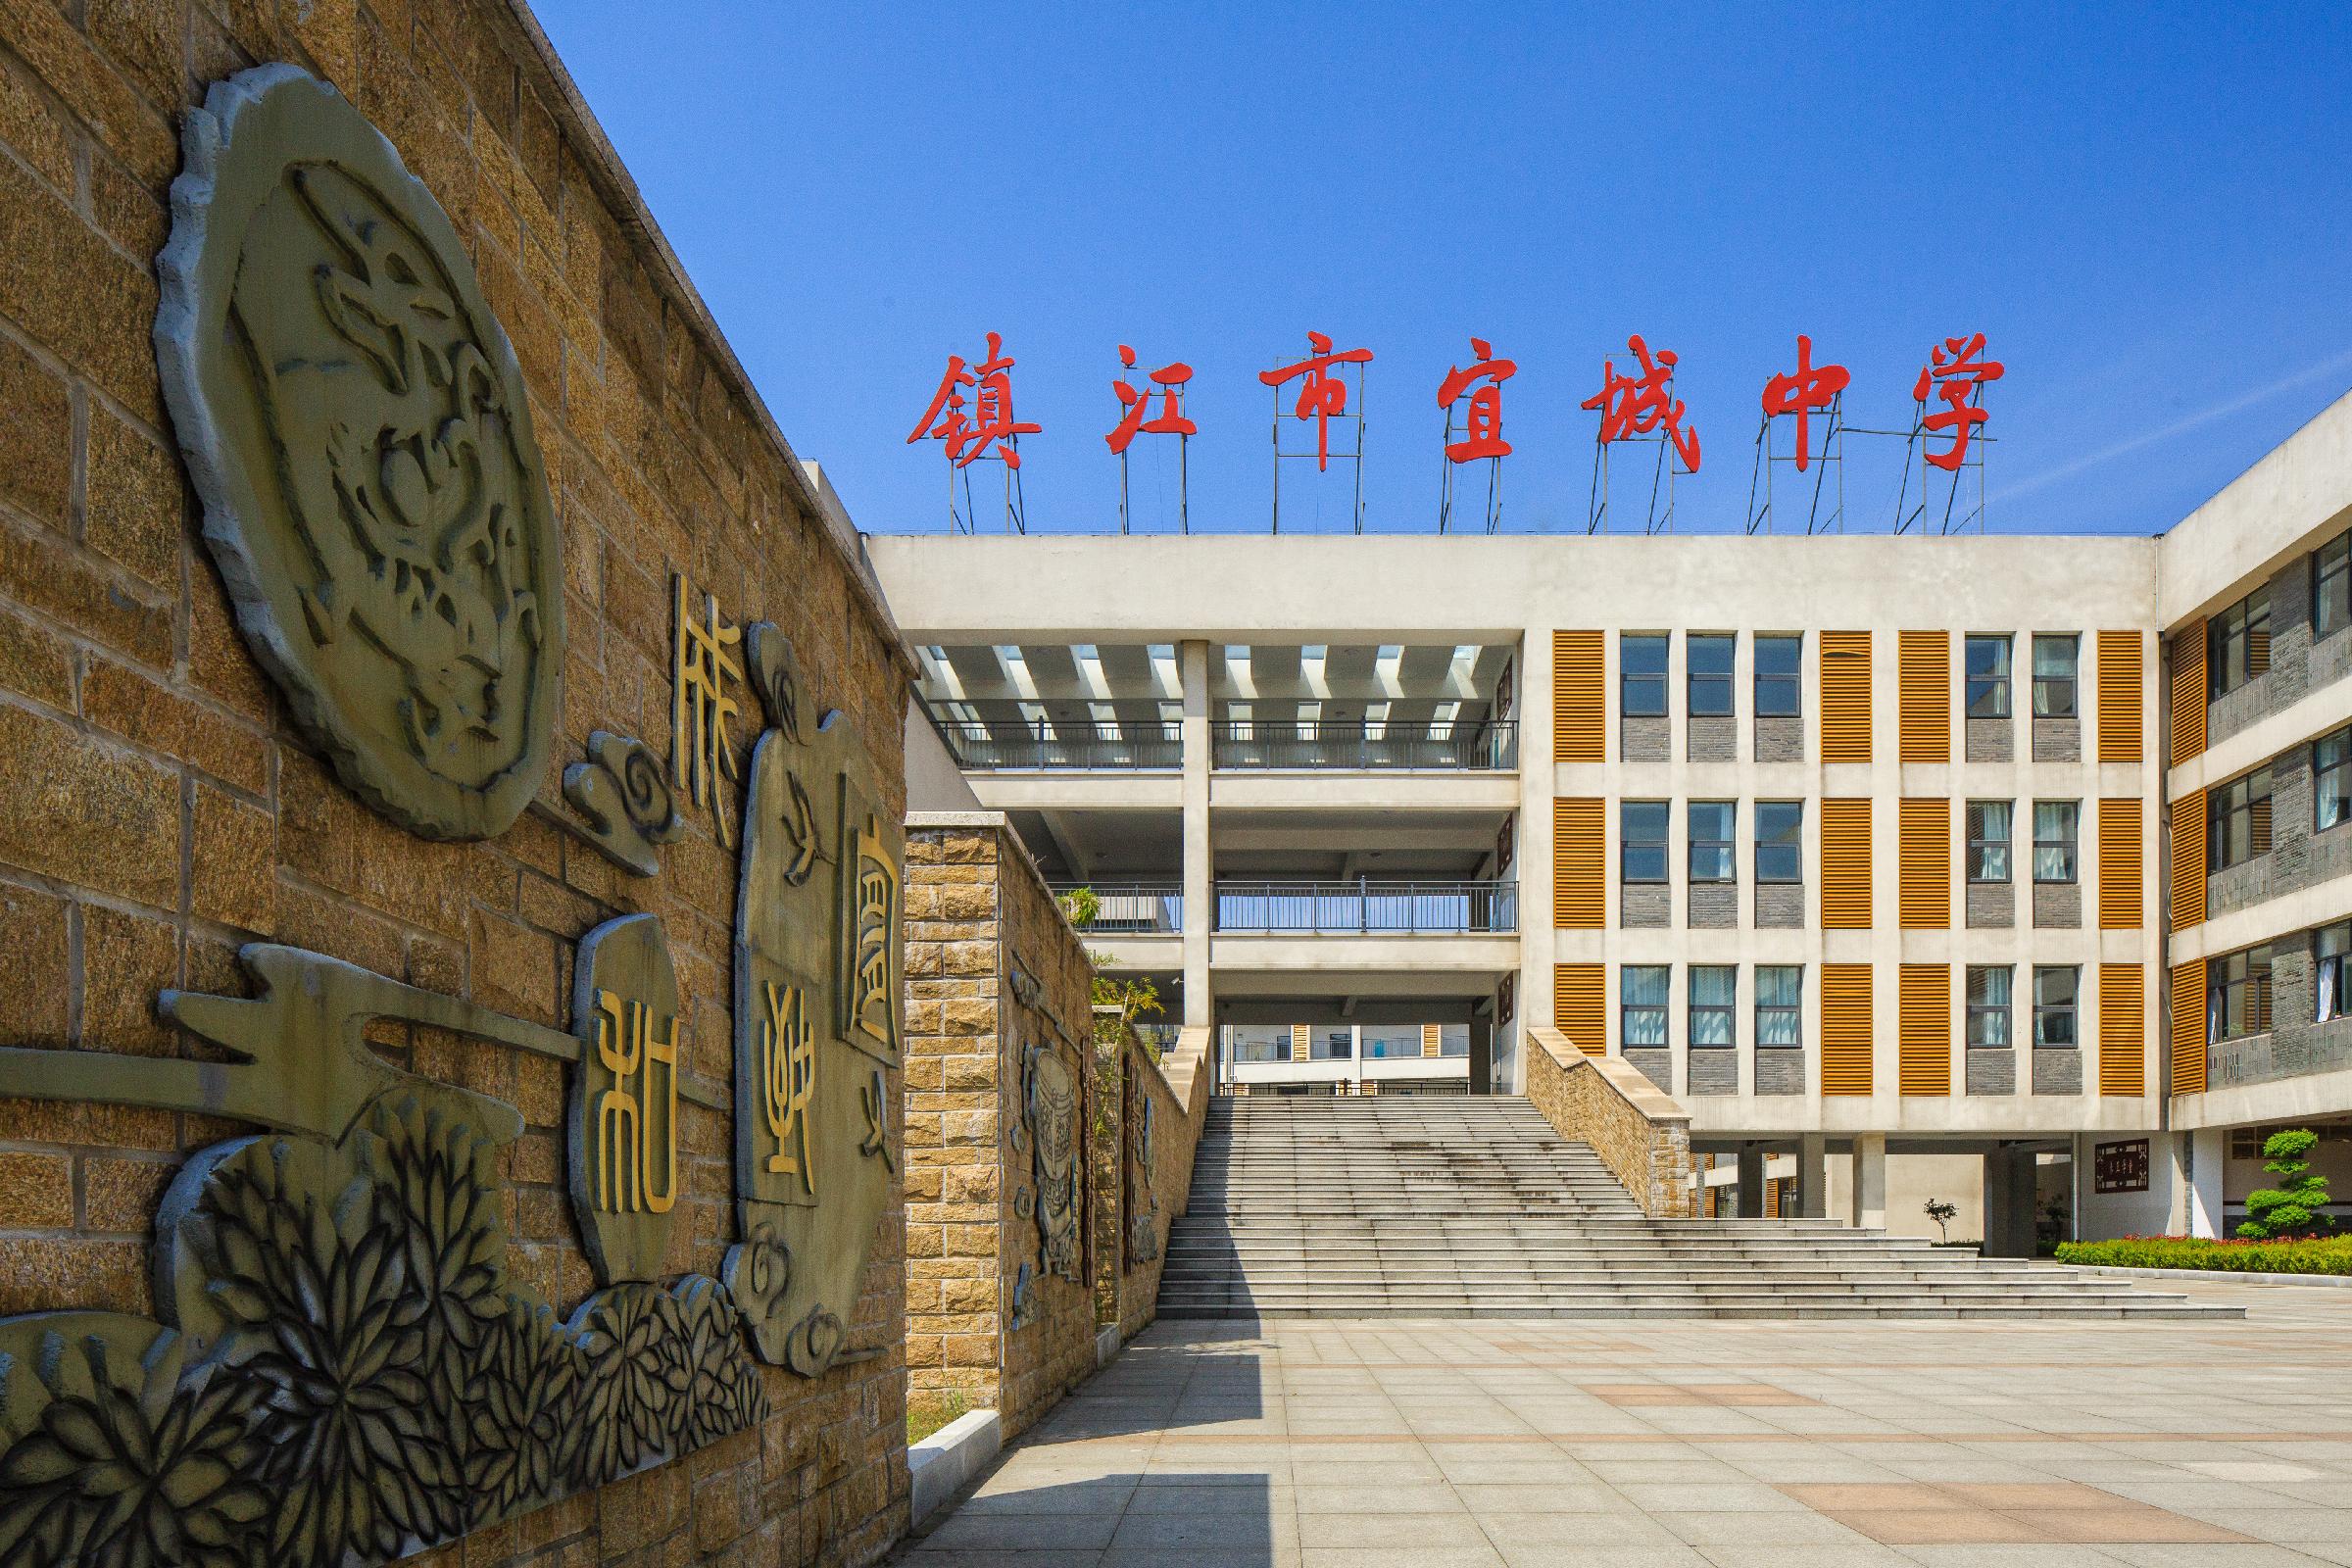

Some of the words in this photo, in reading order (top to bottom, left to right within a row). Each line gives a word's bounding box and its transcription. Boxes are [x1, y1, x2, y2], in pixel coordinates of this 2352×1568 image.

[907, 330, 2004, 473] 镇江市宜城中学
